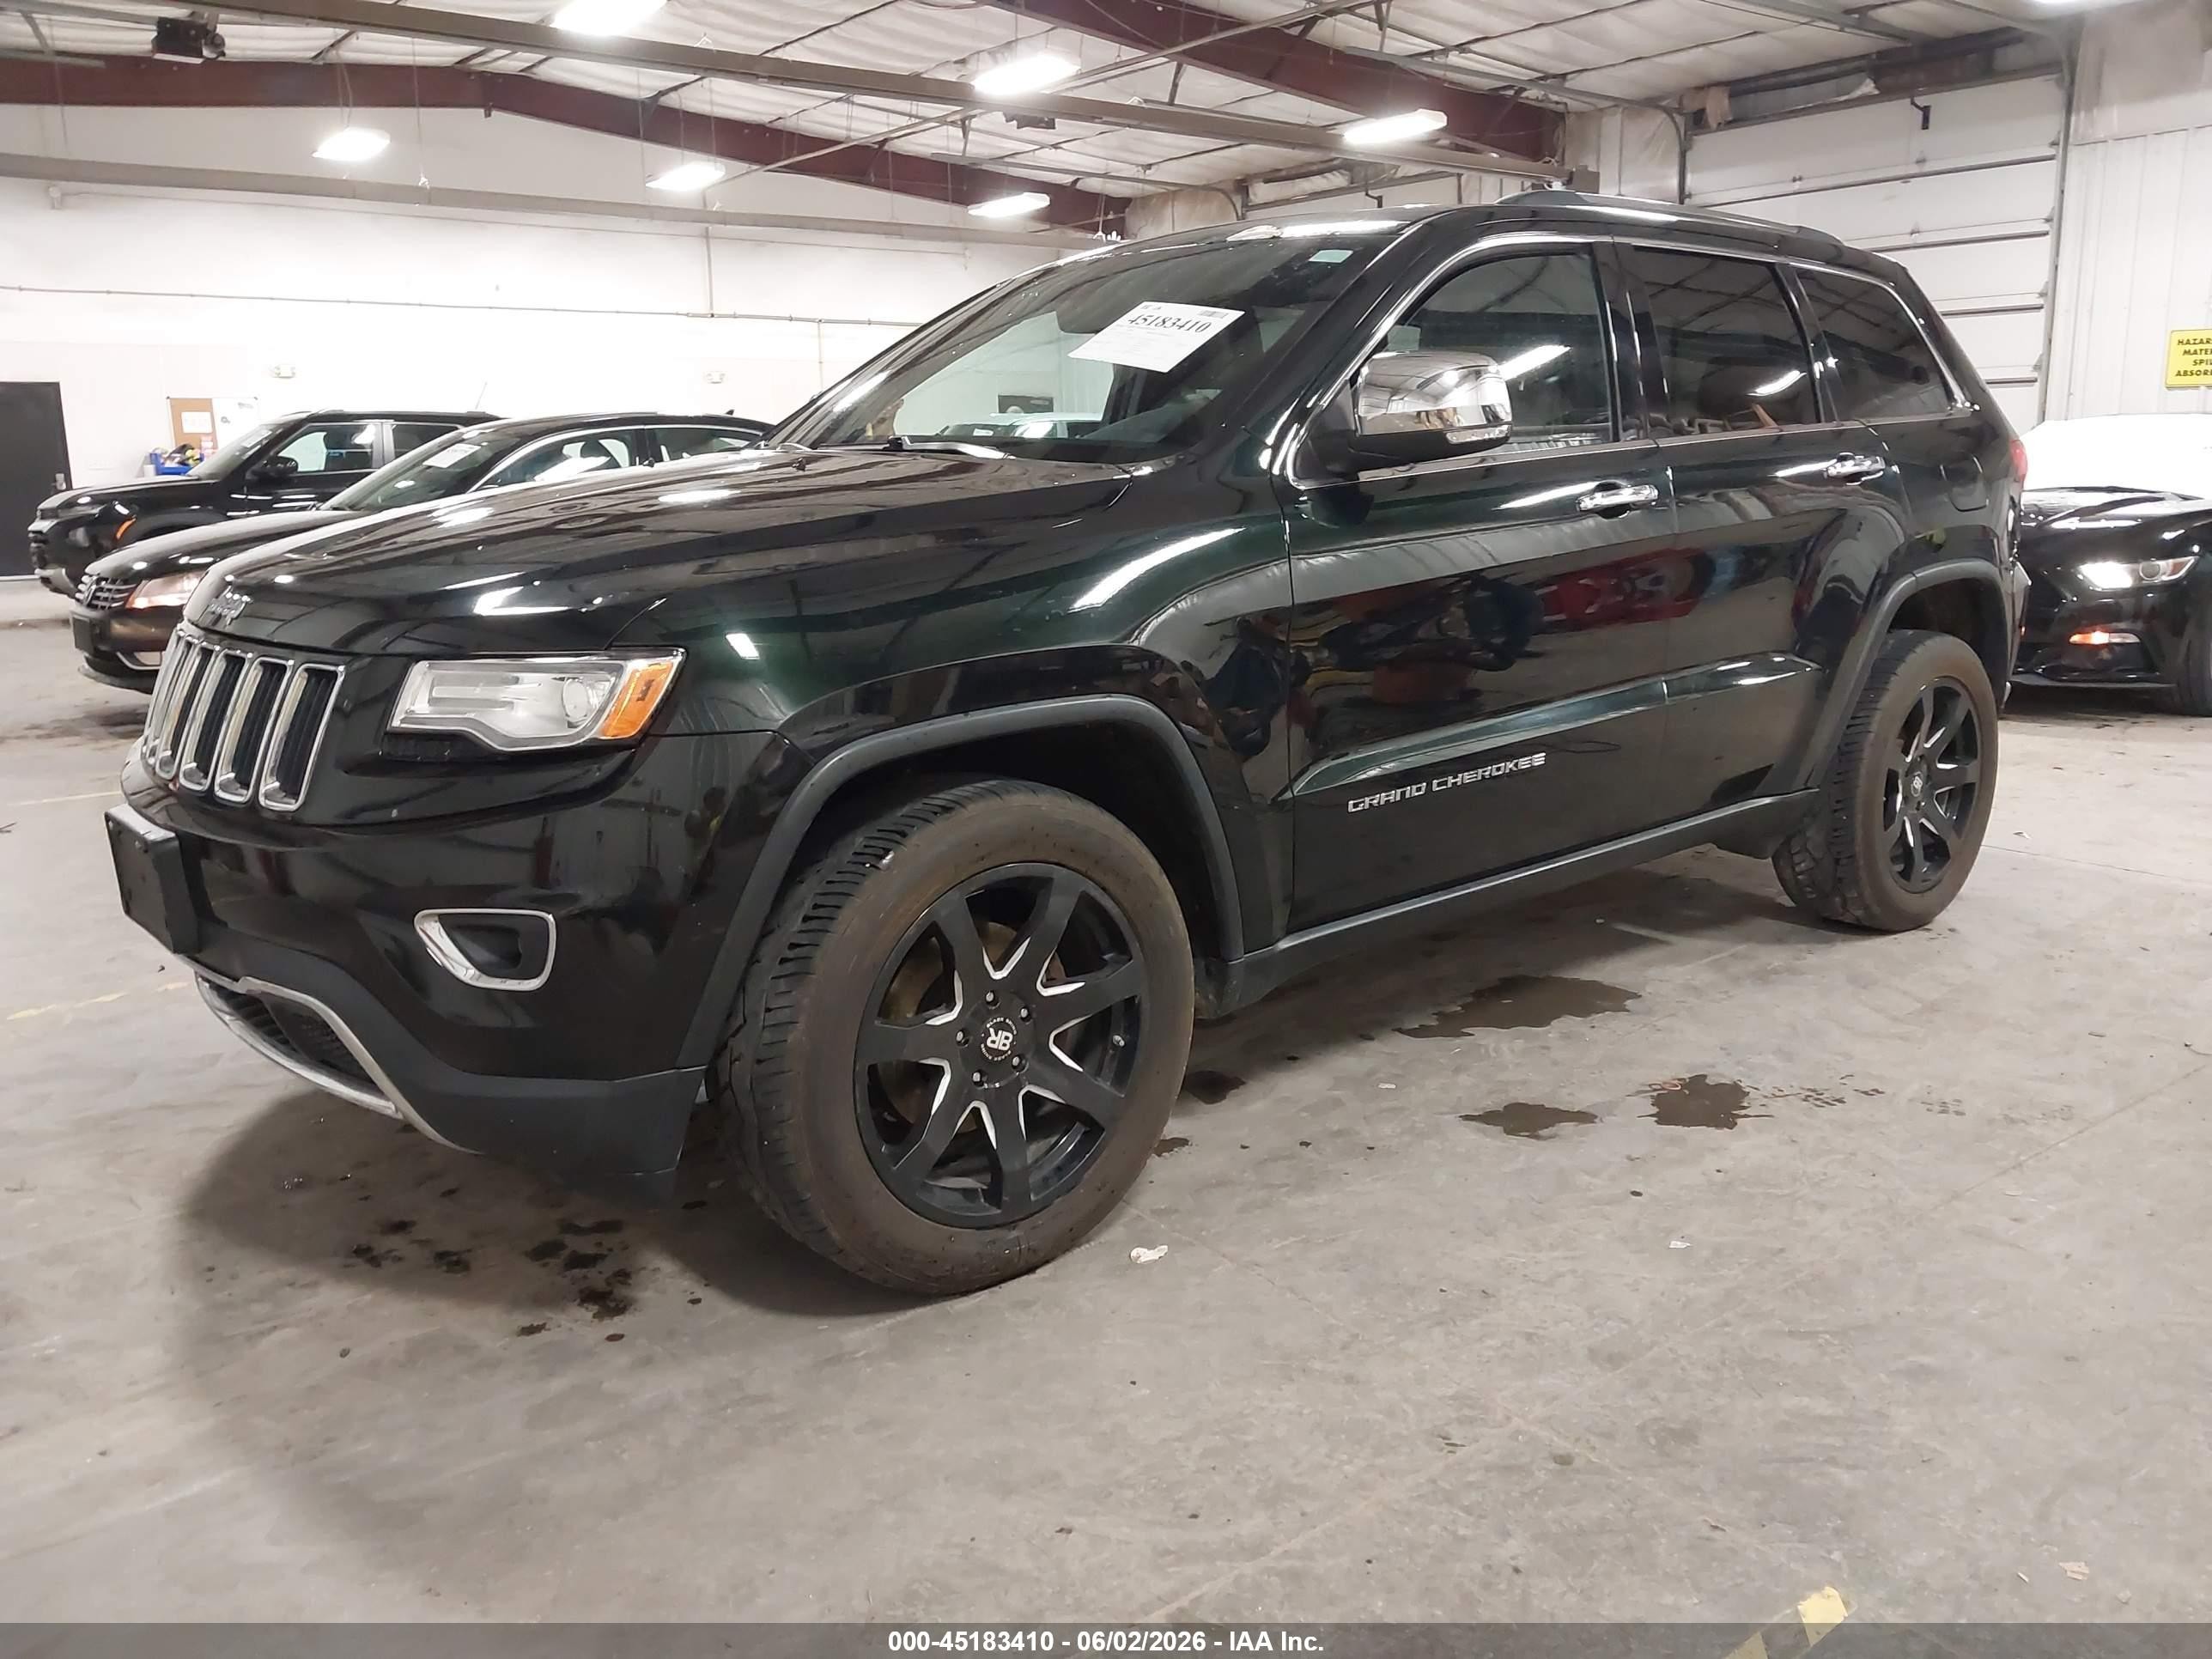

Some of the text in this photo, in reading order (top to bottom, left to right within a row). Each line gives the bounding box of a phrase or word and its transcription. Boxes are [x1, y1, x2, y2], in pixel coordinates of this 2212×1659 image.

[1127, 313, 1212, 333] 45183410
[1347, 752, 1547, 813] GRAND CHEROKEE
